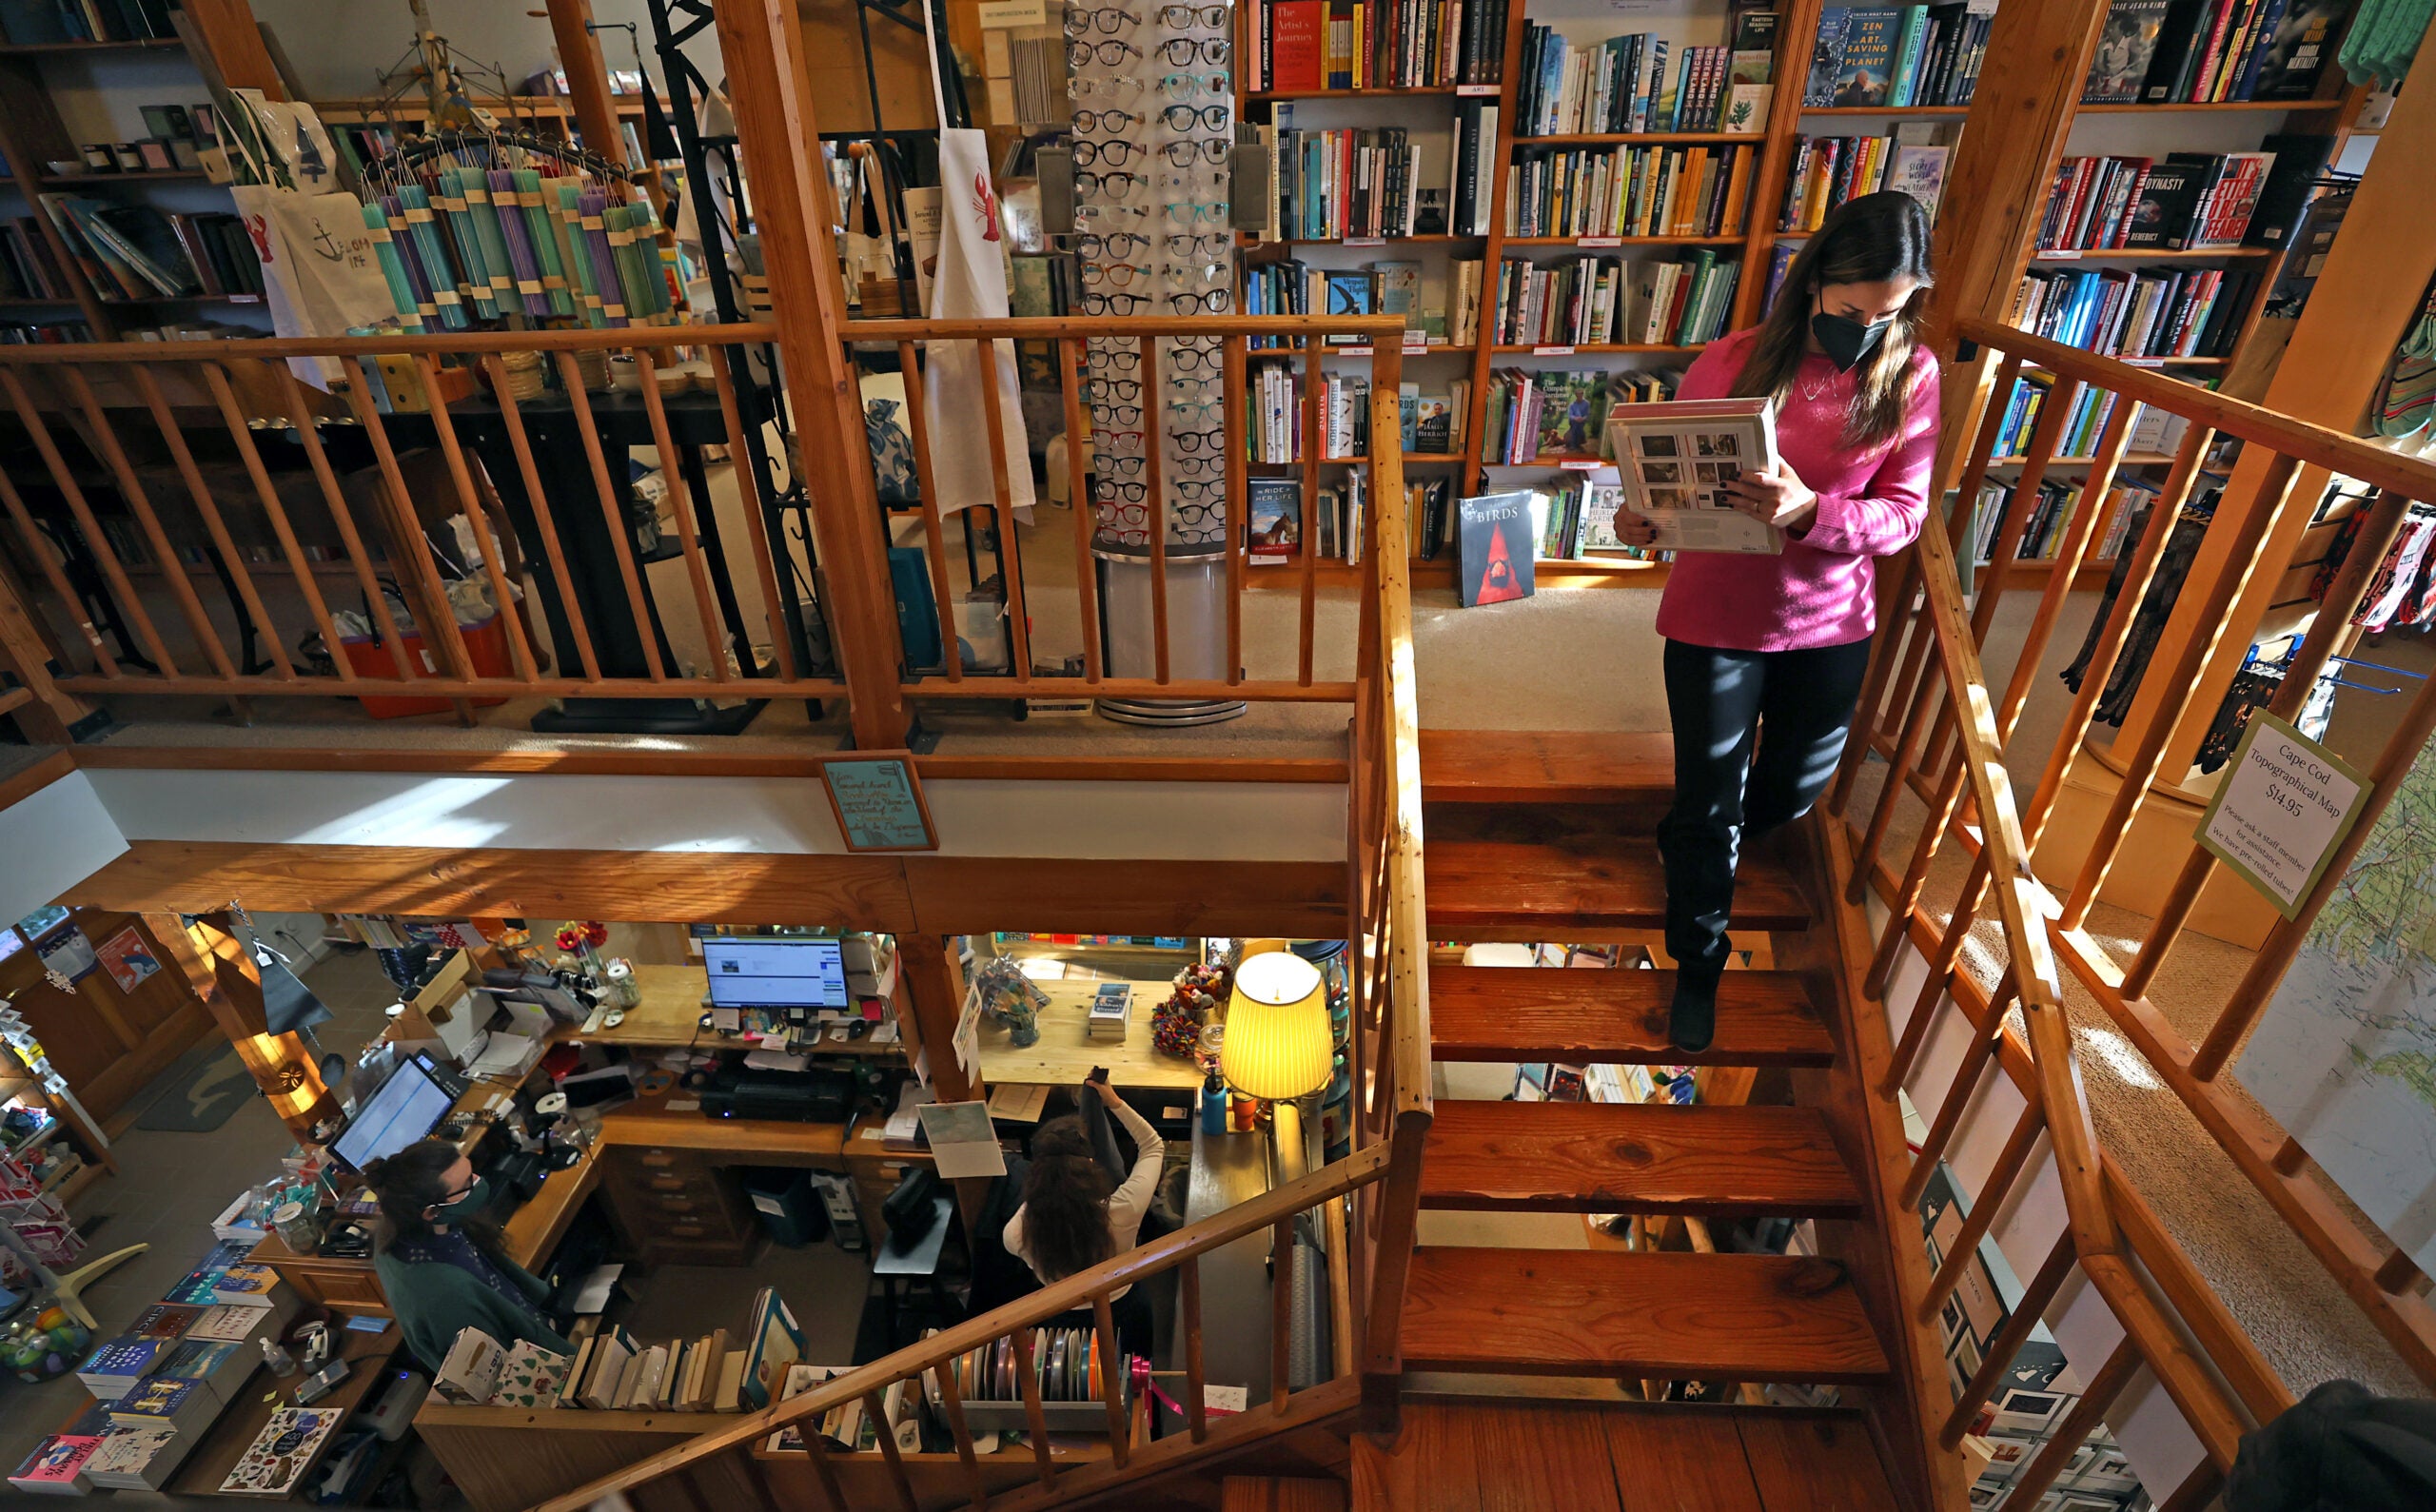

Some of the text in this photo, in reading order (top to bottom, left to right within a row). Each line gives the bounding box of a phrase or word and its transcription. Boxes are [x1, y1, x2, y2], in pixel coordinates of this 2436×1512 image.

[1278, 7, 1294, 17] The
[1279, 20, 1309, 29] Artist's
[1862, 22, 1883, 30] ZEN
[1276, 32, 1312, 44] Journey
[1847, 45, 1888, 53] SAVING
[1687, 47, 1703, 100] UNDERLAND
[1697, 47, 1715, 100] UNDERLAND
[1709, 47, 1726, 100] UNDERLAND
[1845, 58, 1885, 67] PLANET
[2145, 178, 2185, 190] DYNASTY
[2214, 179, 2254, 200] ETTER
[2131, 233, 2158, 242] BENEDICT
[2204, 220, 2249, 239] FEARED
[2171, 296, 2191, 345] POWER PLAY
[1329, 383, 1338, 416] SIBLEY
[1477, 506, 1518, 523] BIRDS
[2279, 744, 2331, 785] Cape Cod
[2250, 748, 2341, 819] Topographical Map
[2266, 783, 2304, 817] $14.95
[2224, 805, 2244, 825] Please
[2244, 821, 2256, 833] ask
[2262, 833, 2279, 848] staff
[2278, 845, 2307, 873] member
[2236, 829, 2282, 870] for assistance.
[2212, 827, 2294, 895] We have pre-rolled tubes!
[184, 1271, 217, 1303] STARS
[103, 1346, 124, 1365] LISA
[109, 1345, 135, 1368] MONA
[119, 1352, 137, 1367] LAST
[128, 1350, 147, 1365] THE
[53, 1443, 87, 1474] DONOVAN
[76, 1438, 101, 1463] FINLAY
